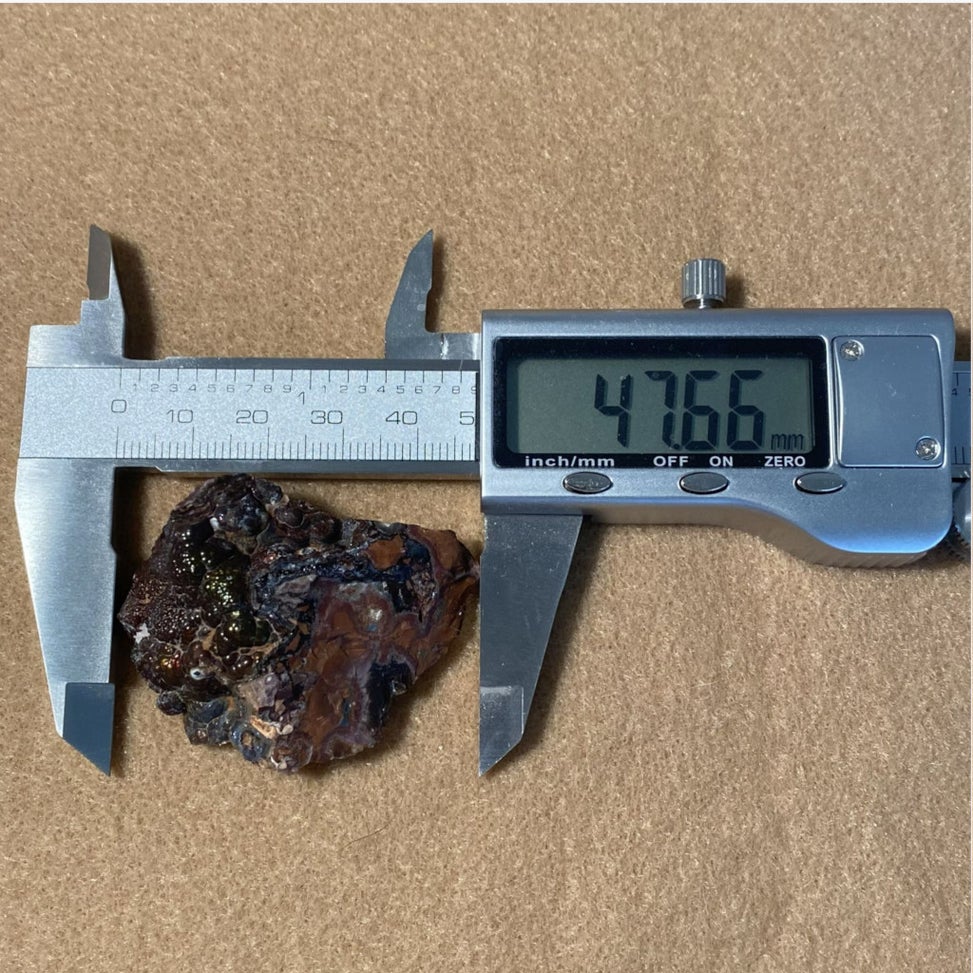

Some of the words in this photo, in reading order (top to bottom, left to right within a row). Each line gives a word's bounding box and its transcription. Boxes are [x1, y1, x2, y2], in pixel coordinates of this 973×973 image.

[111, 399, 127, 413] 0
[166, 409, 194, 424] 10
[235, 409, 269, 424] 20
[310, 410, 343, 425] 30
[385, 410, 418, 425] 40
[593, 369, 764, 451] 47.66
[525, 456, 616, 468] inch/mm
[653, 456, 689, 467] OFF
[709, 456, 734, 467] ON
[764, 456, 806, 467] ZERO
